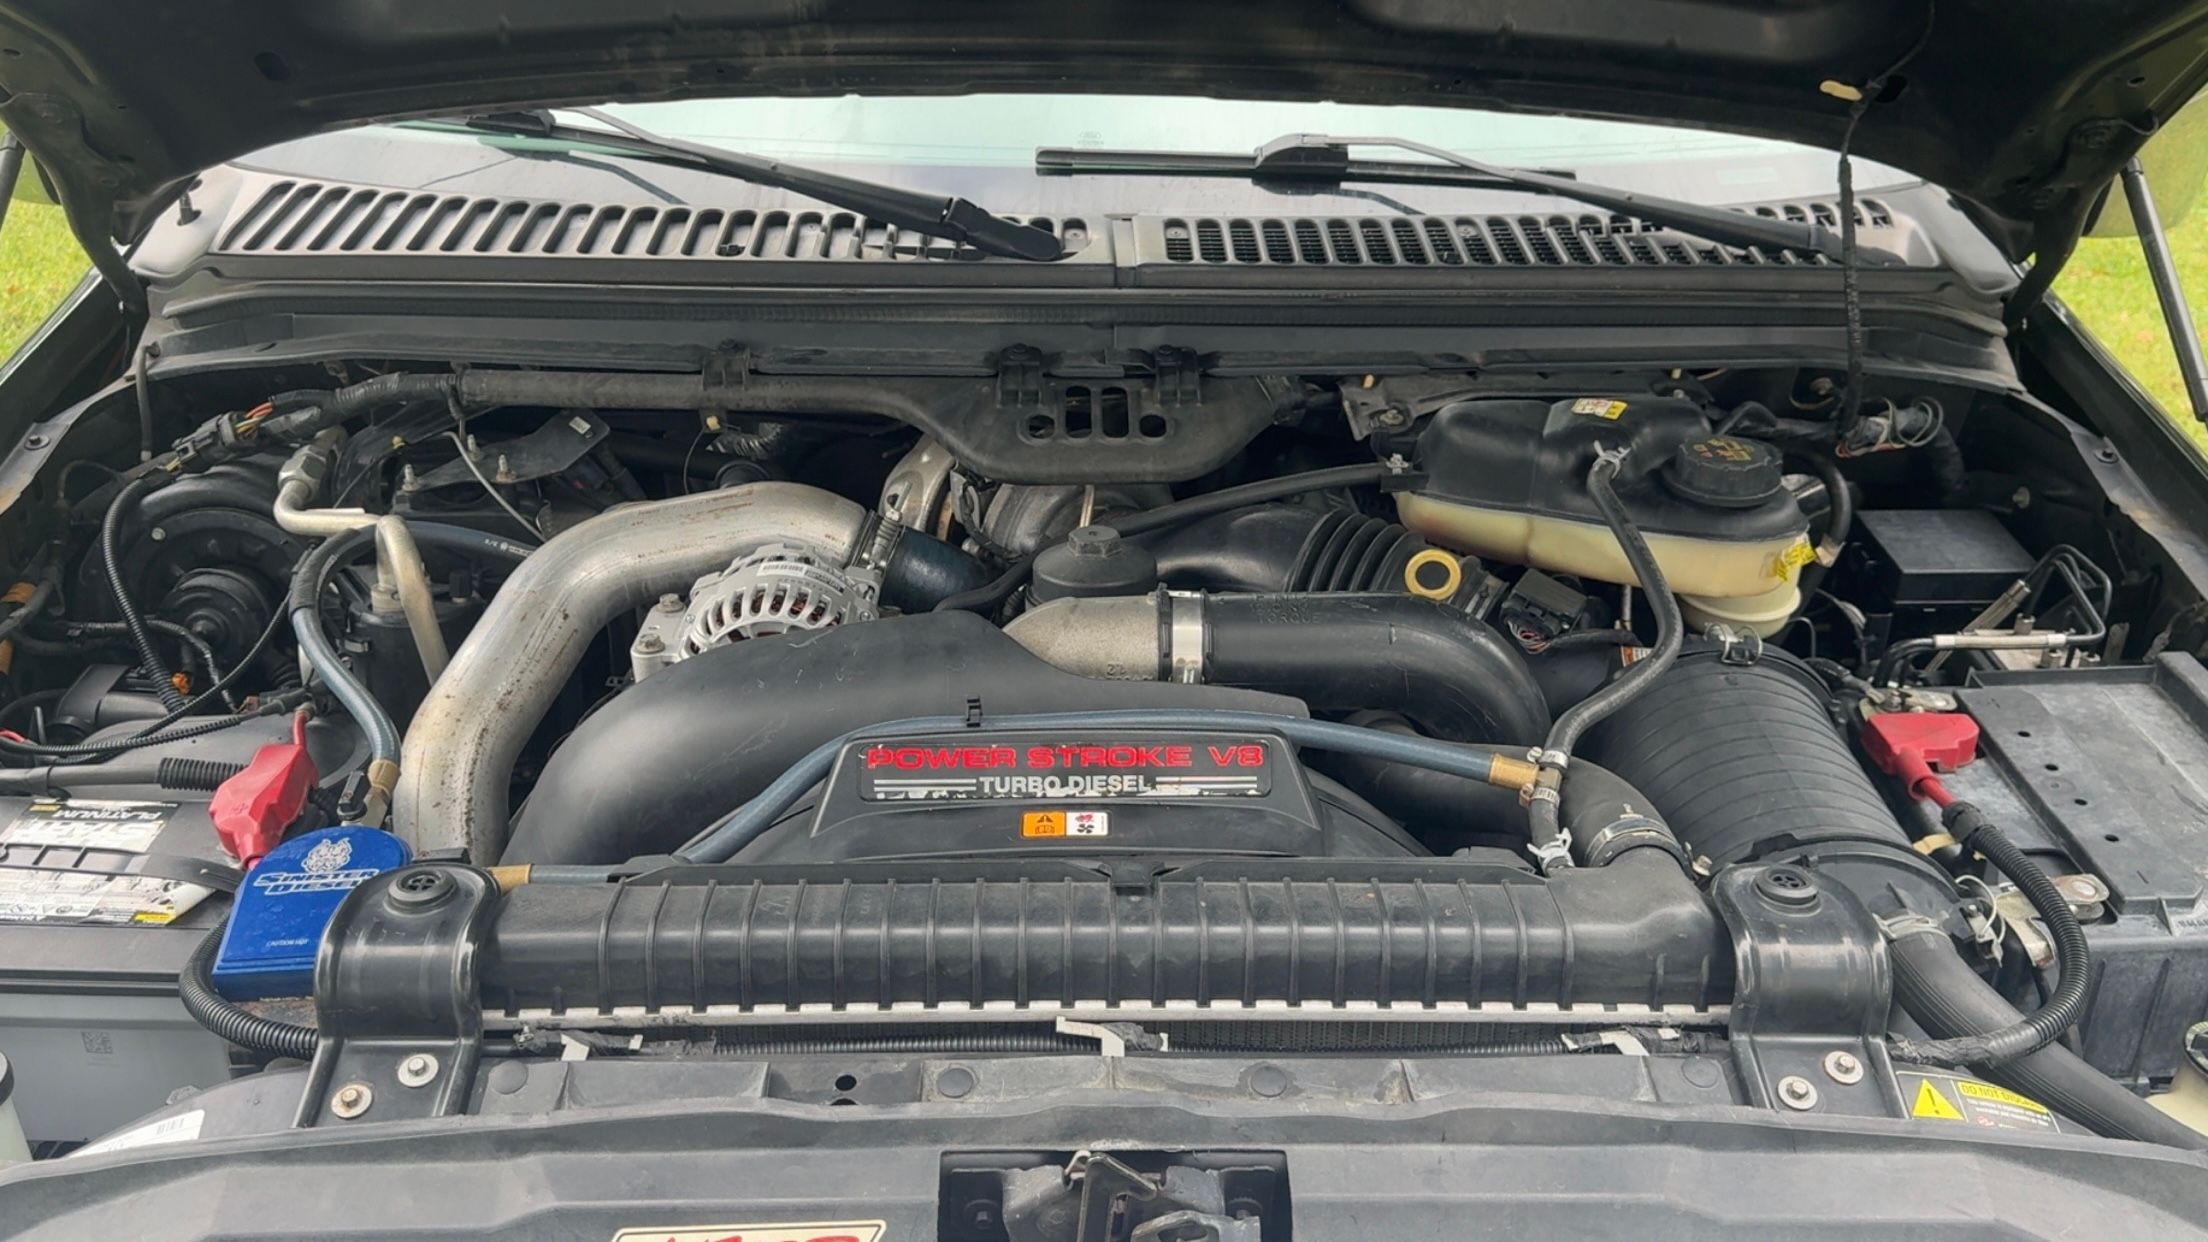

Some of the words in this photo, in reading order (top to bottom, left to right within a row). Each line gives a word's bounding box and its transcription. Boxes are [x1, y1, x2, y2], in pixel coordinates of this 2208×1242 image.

[867, 746, 1016, 769] POWER
[1028, 745, 1193, 768] STROKE
[1208, 745, 1264, 767] V8
[979, 776, 1063, 793] TURBO
[1067, 775, 1151, 793] DIESEL
[52, 809, 162, 819] PLATINUM
[254, 869, 379, 886] SINISTER
[1962, 1085, 1977, 1095] DO
[1980, 1087, 1998, 1097] NOT
